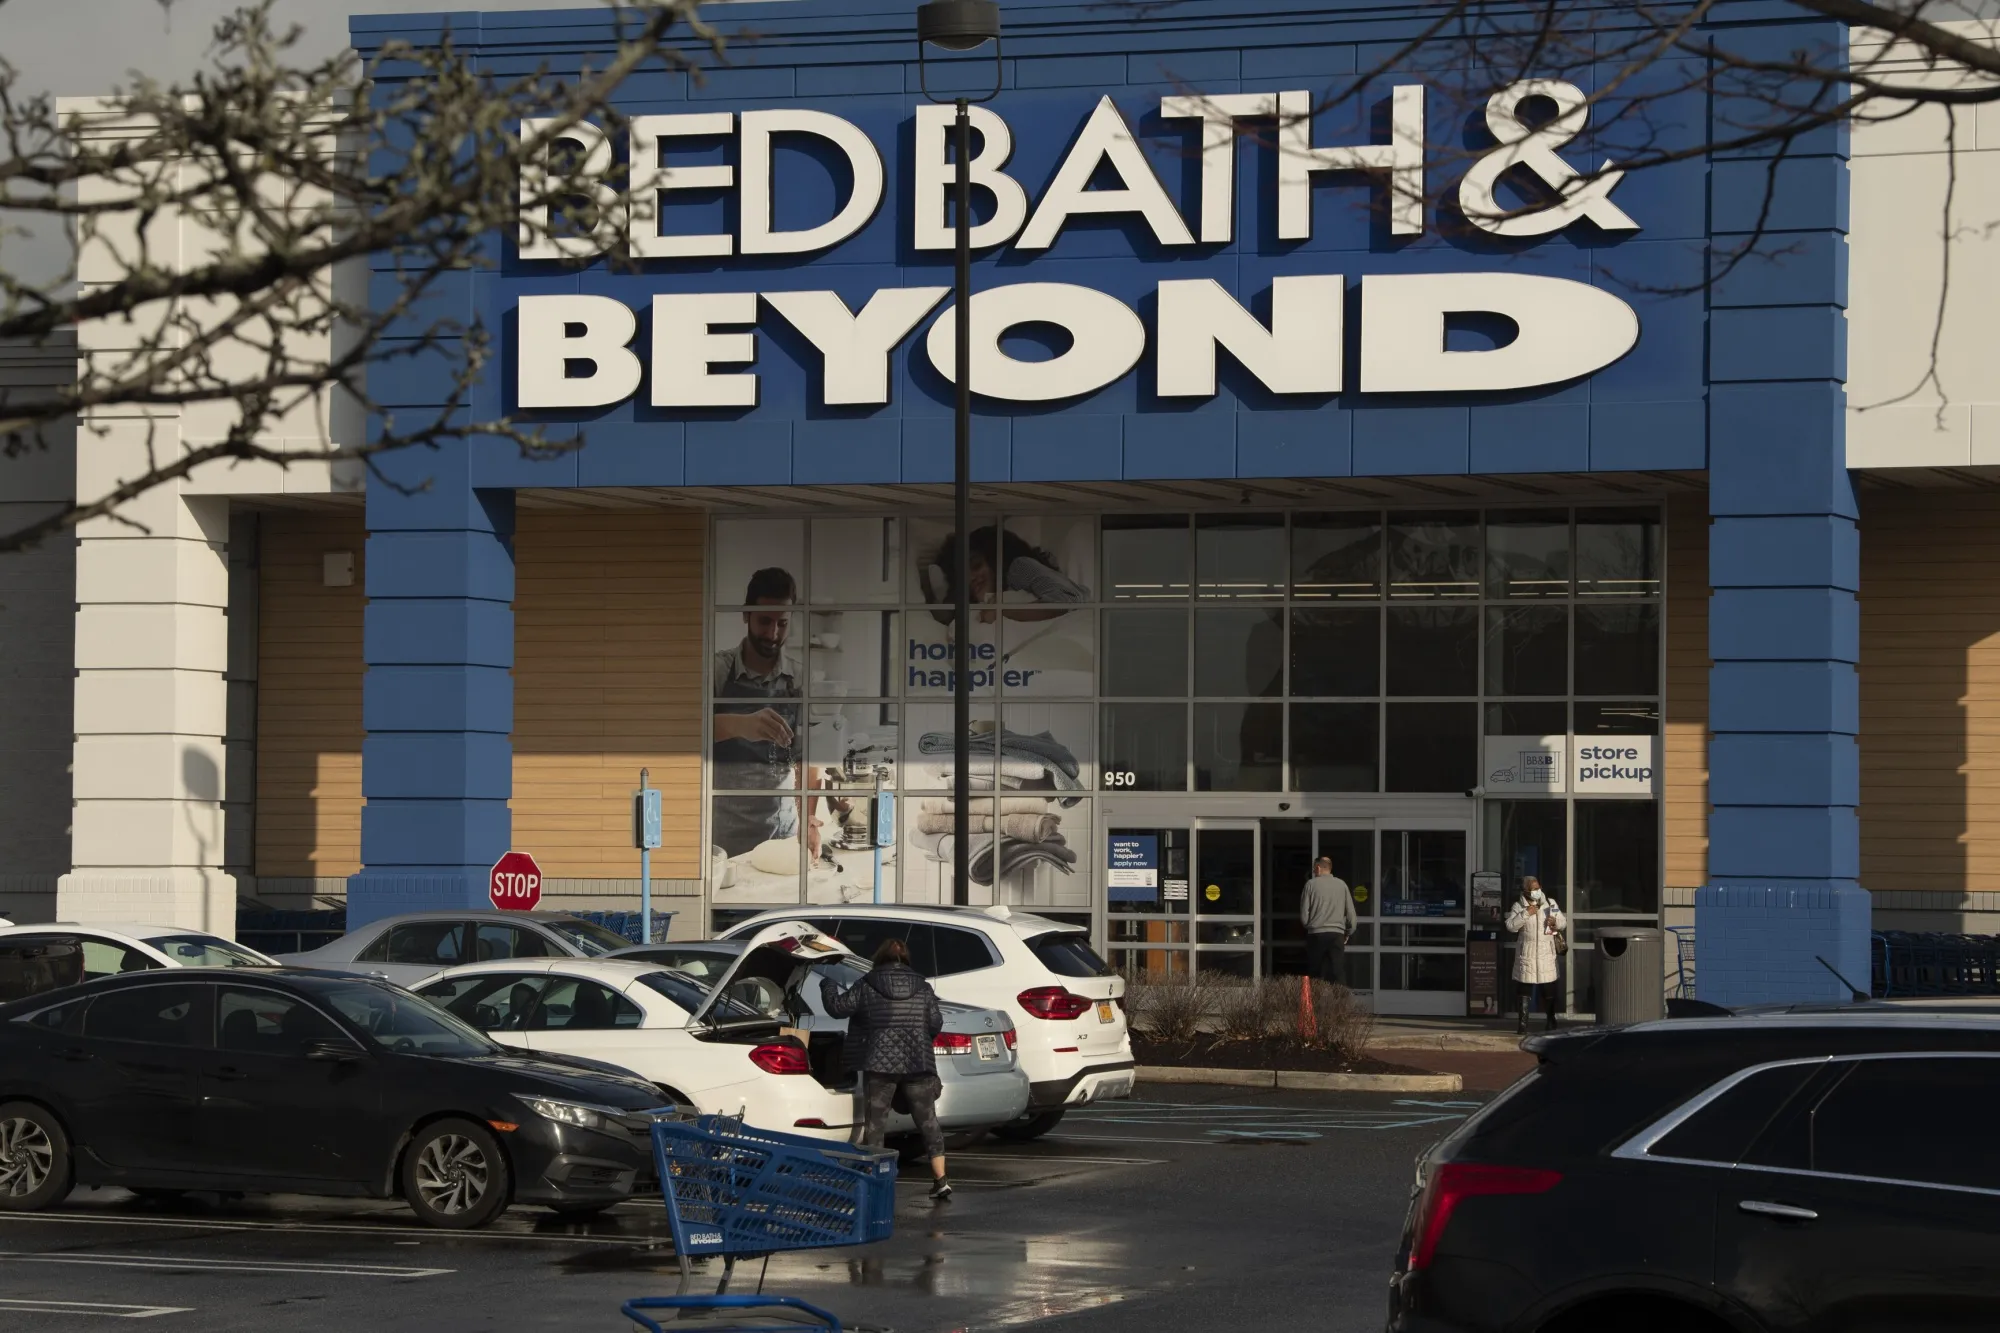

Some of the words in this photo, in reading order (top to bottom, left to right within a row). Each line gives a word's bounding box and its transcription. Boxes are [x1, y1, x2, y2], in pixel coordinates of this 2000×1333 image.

[519, 108, 886, 260] BED
[914, 84, 1426, 251] BATH
[1458, 78, 1642, 238] &
[517, 271, 1640, 409] BEYOND
[1526, 755, 1553, 765] BB&B
[1580, 746, 1638, 760] store
[1104, 771, 1135, 787] 950
[1580, 764, 1653, 783] pickup
[493, 872, 539, 898] STOP
